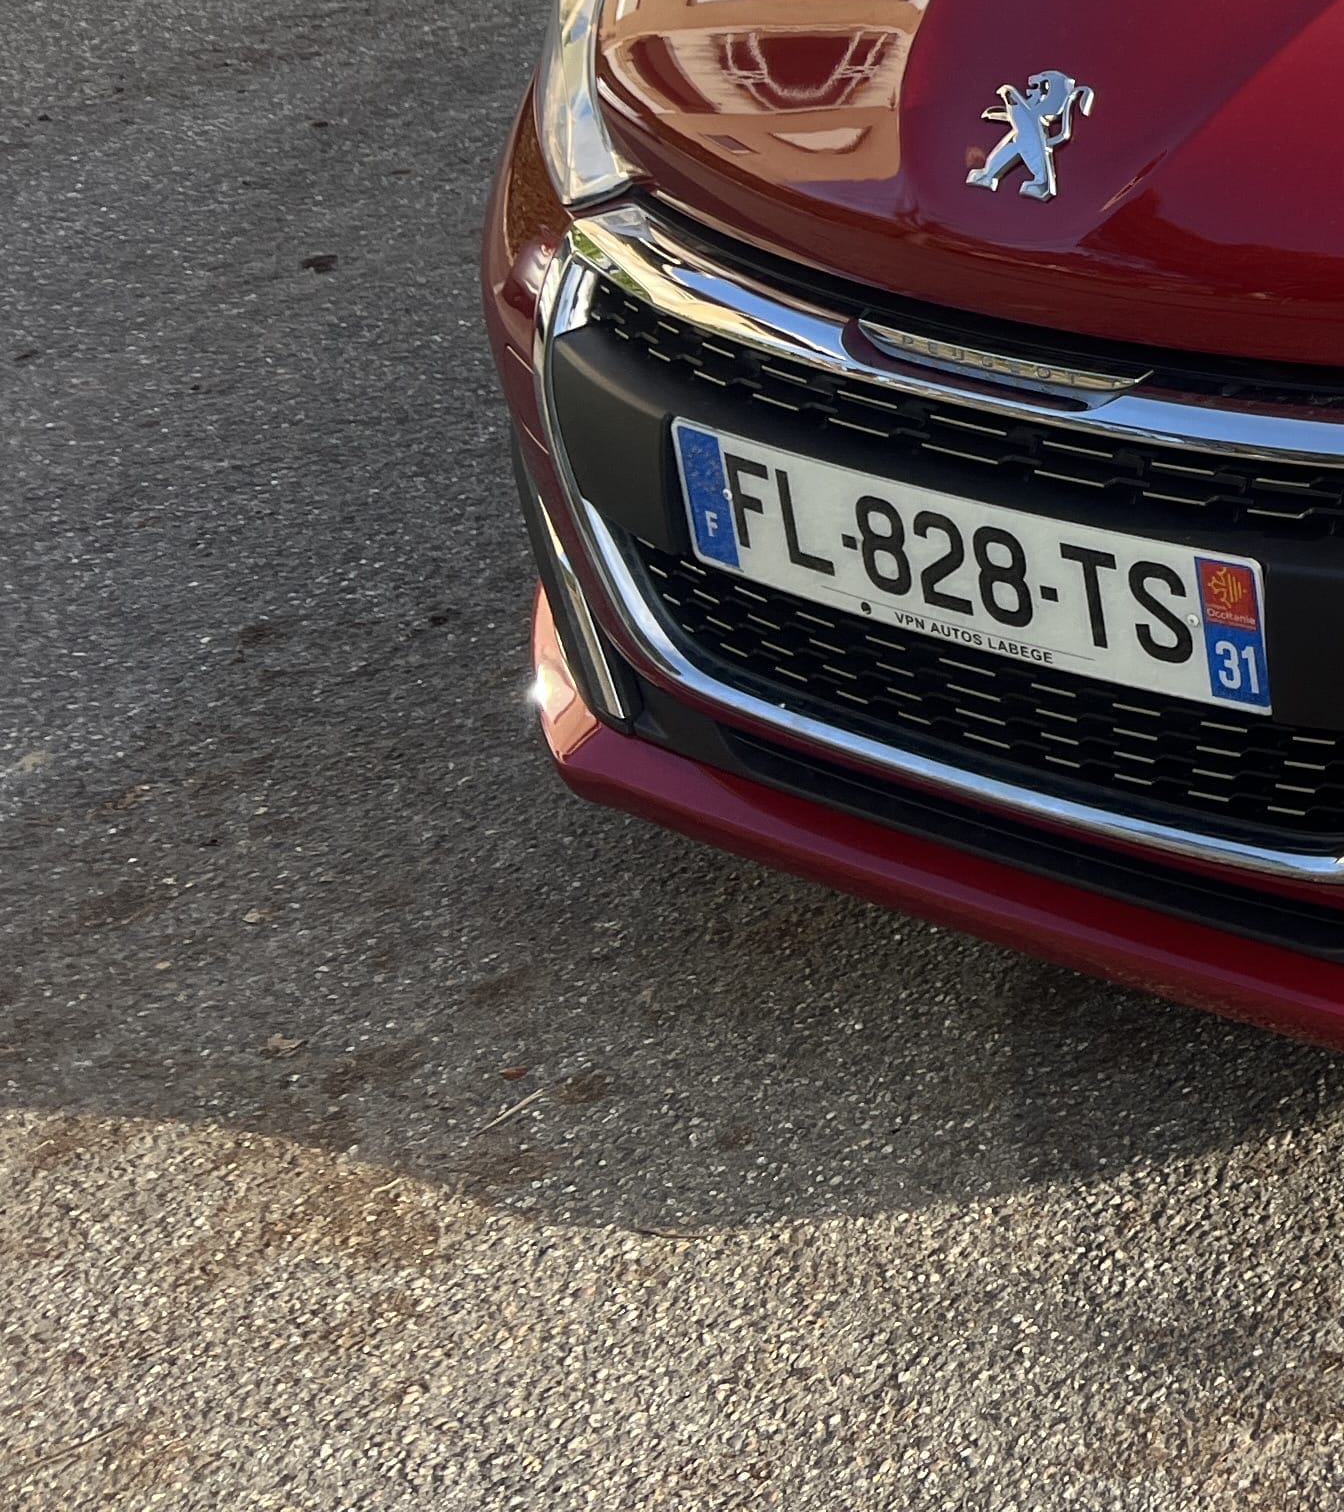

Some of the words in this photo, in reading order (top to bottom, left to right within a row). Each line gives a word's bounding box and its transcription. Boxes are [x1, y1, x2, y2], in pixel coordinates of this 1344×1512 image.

[902, 335, 1078, 385] PEUGEOT
[704, 509, 719, 538] F
[723, 452, 1194, 664] FL-828-TS
[894, 611, 926, 631] VPN
[930, 621, 984, 647] AUTOS
[988, 637, 1054, 665] LABEGE
[1215, 640, 1260, 695] 31
